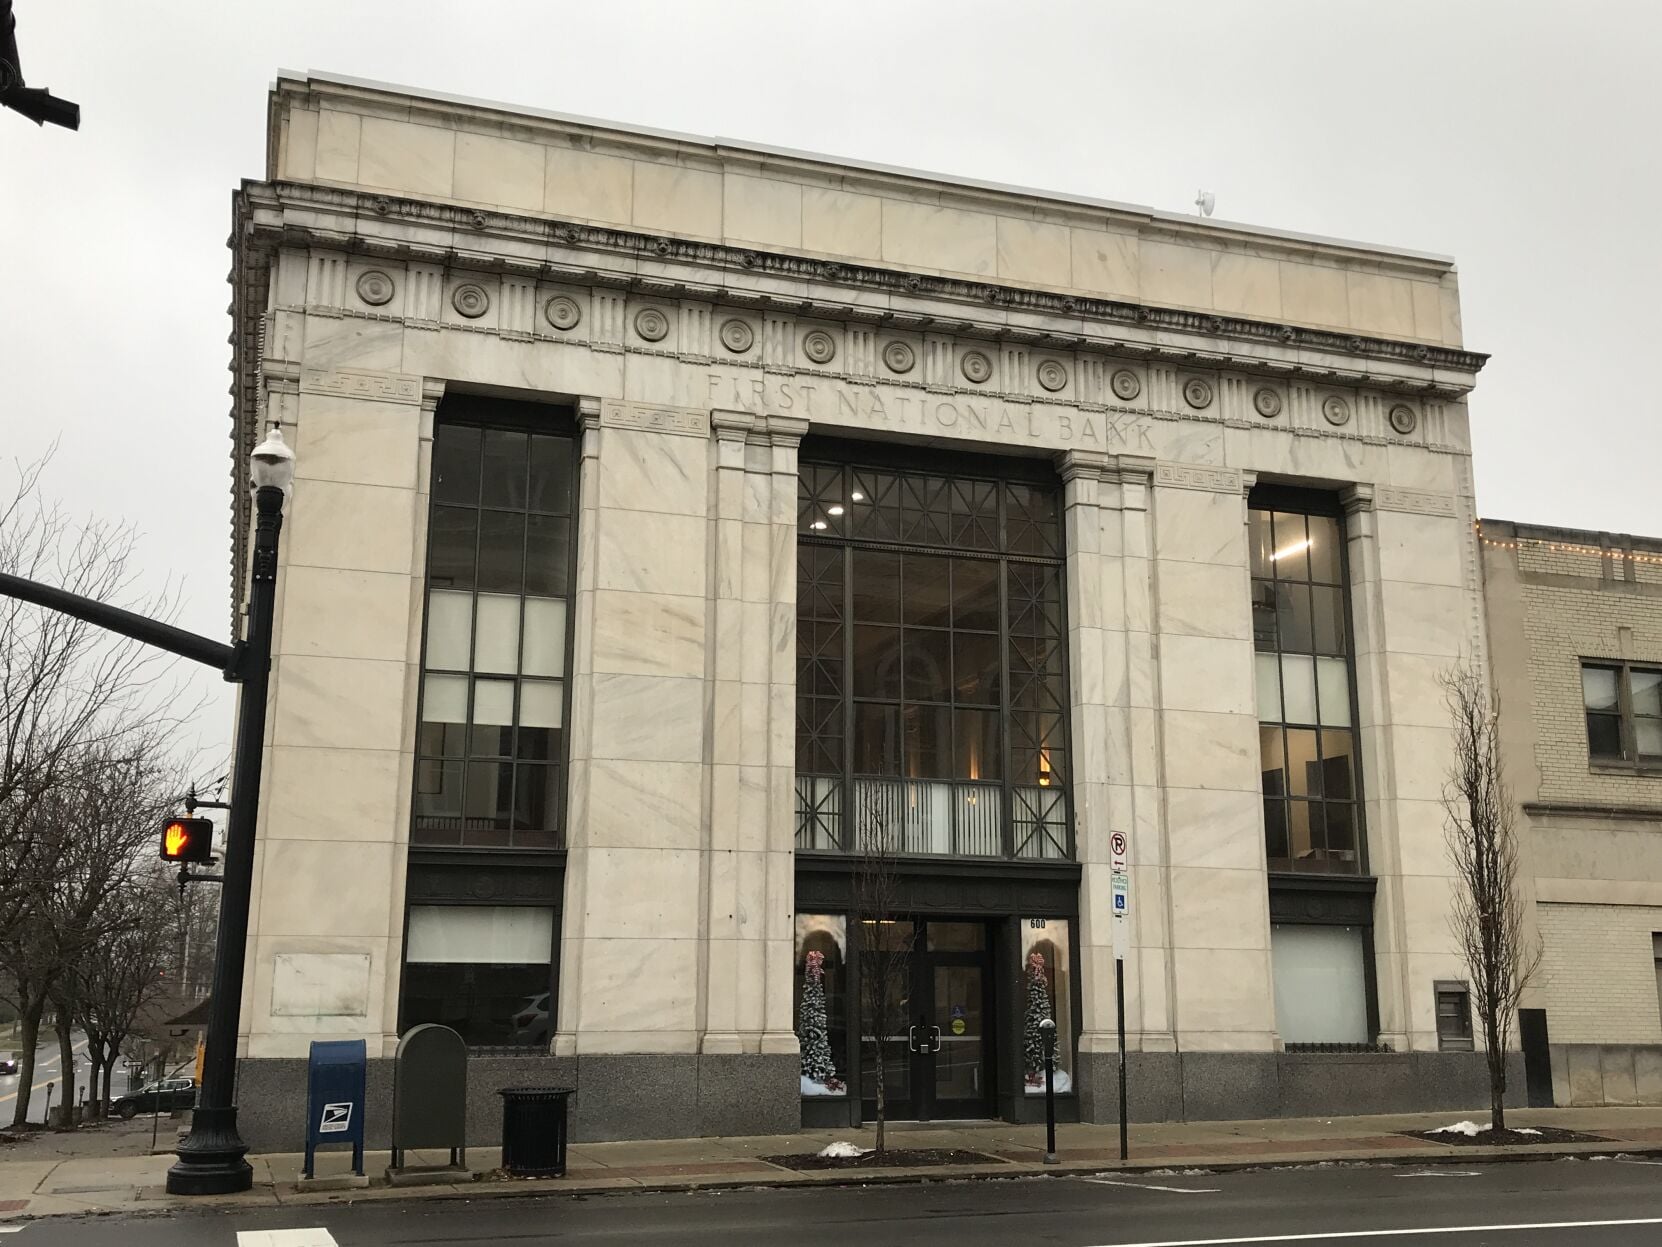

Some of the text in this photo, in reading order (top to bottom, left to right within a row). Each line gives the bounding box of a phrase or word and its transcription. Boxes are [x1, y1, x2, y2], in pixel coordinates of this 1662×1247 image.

[707, 374, 1157, 450] FIRST NATIONAL BANK
[1030, 919, 1046, 929] 600
